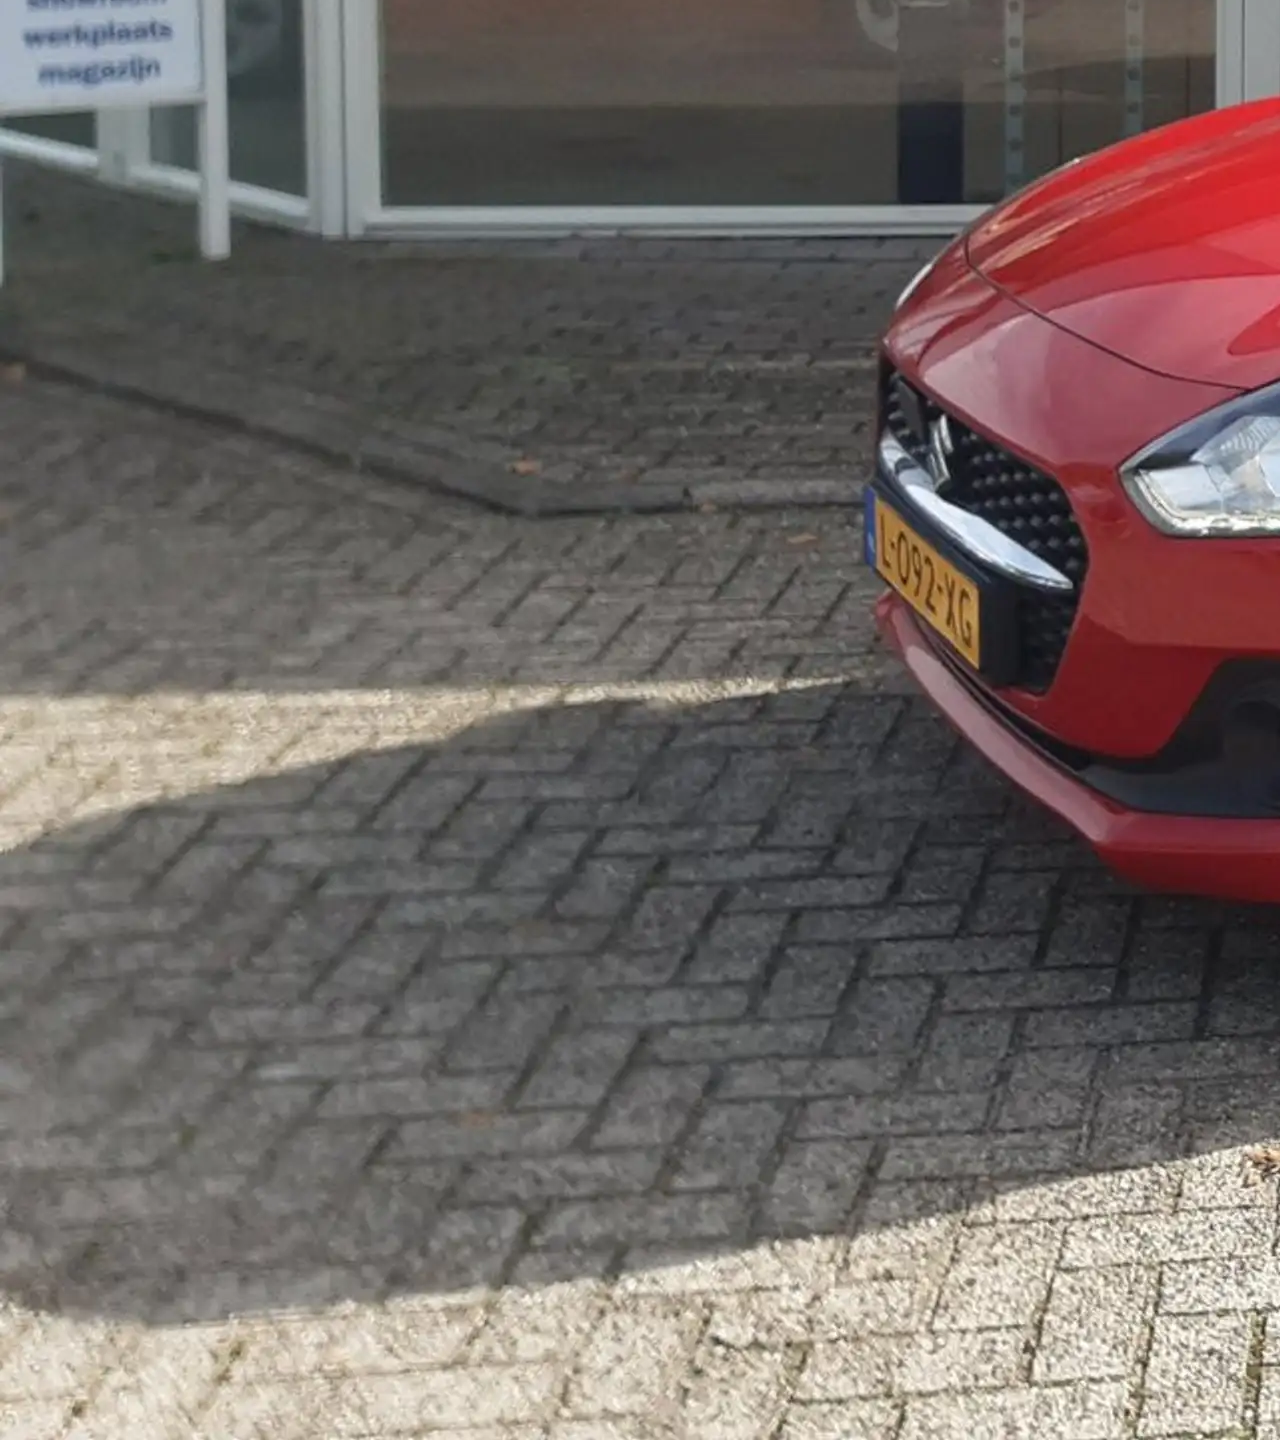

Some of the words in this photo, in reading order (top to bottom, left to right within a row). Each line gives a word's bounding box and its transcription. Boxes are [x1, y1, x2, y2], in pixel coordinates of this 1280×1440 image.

[22, 20, 173, 50] werkplaats
[38, 55, 161, 86] magazijn
[879, 513, 973, 649] L-092-XG
